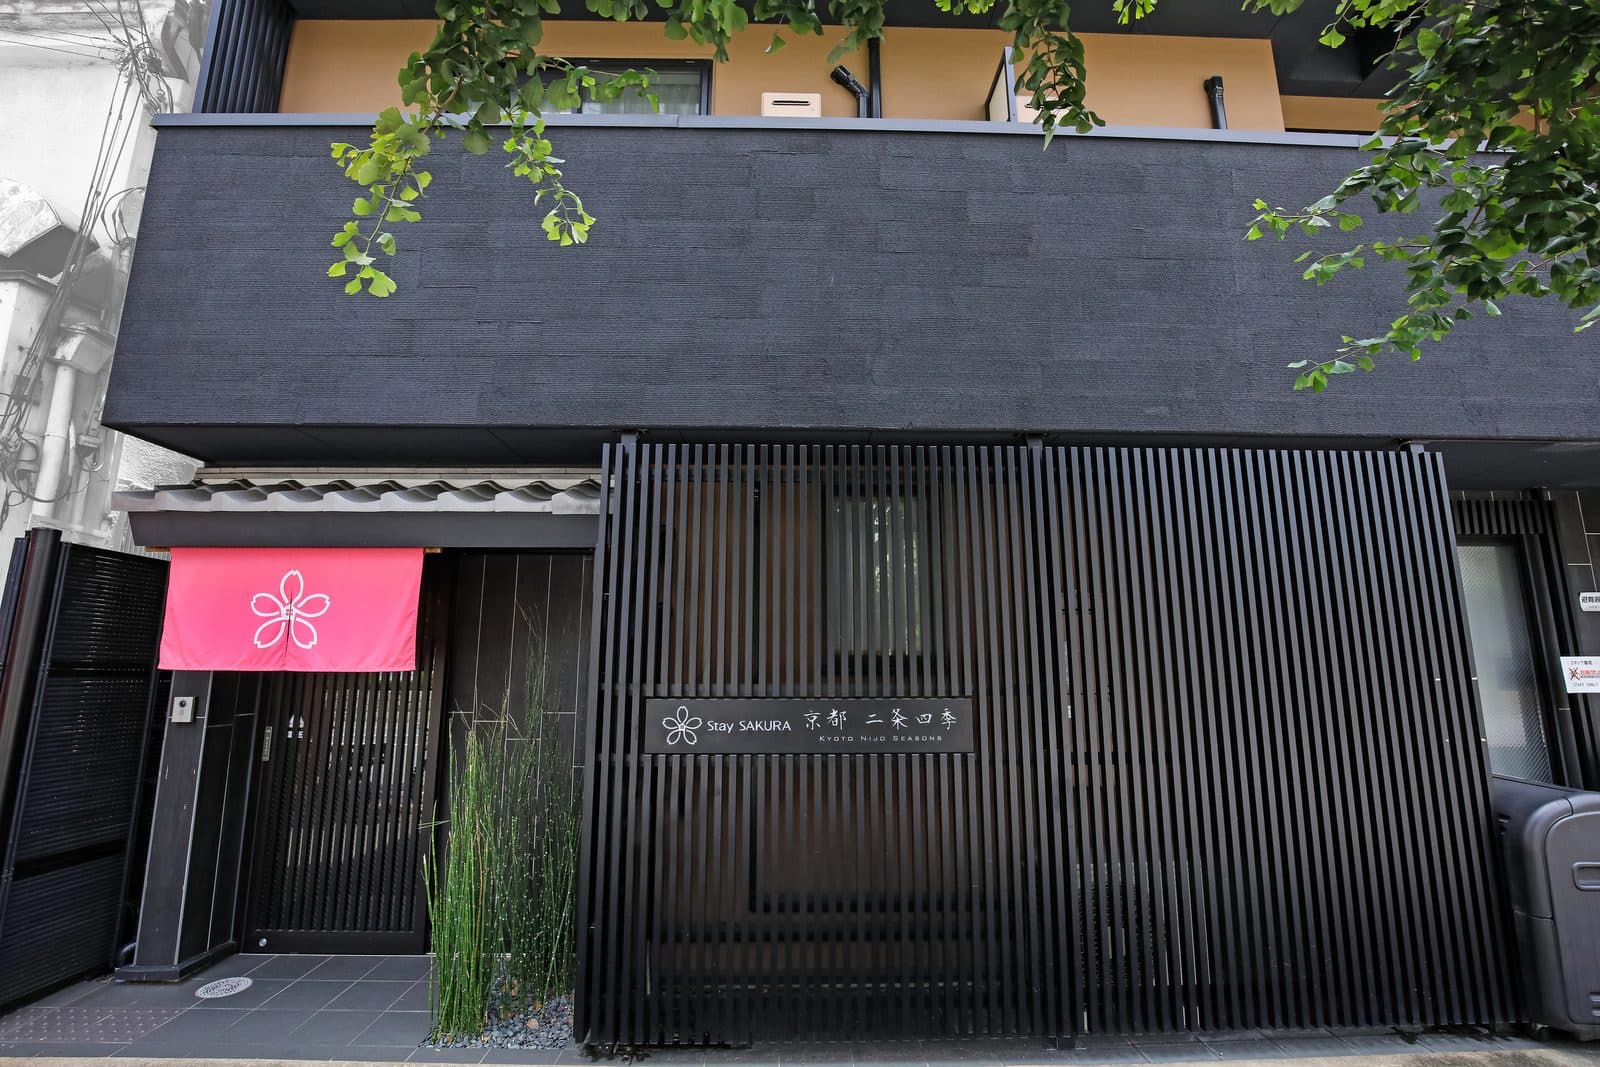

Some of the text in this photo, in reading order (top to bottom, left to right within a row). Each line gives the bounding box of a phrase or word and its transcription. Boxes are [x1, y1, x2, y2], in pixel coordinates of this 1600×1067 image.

[707, 720, 791, 734] Stay SAKURA
[804, 708, 957, 730] 京都 二条四季
